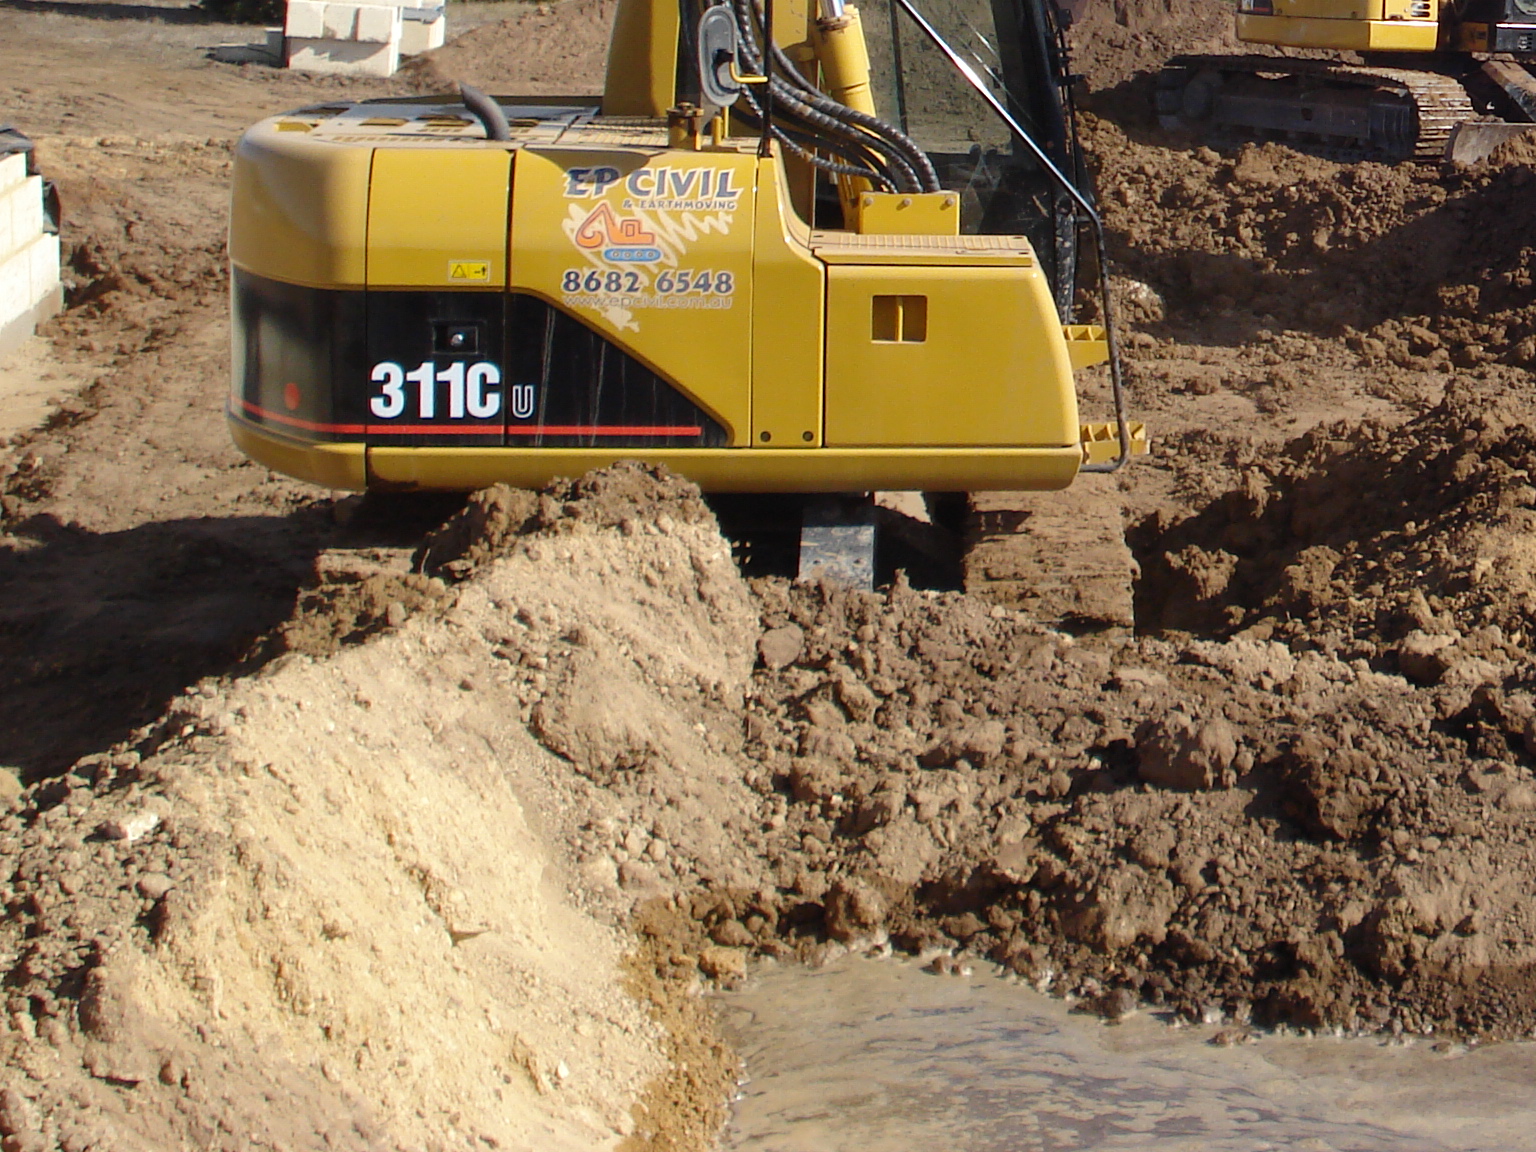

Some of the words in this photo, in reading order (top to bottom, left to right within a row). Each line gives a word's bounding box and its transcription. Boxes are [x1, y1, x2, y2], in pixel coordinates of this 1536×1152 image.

[564, 166, 622, 198] EP
[626, 166, 743, 198] CIVIL
[623, 200, 633, 209] &
[640, 200, 736, 210] EARTHMOVING
[562, 270, 641, 294] 8682
[656, 271, 733, 295] 6548
[563, 295, 732, 308] www.epcivil.com.au
[370, 361, 500, 419] 311C
[512, 384, 534, 419] U
